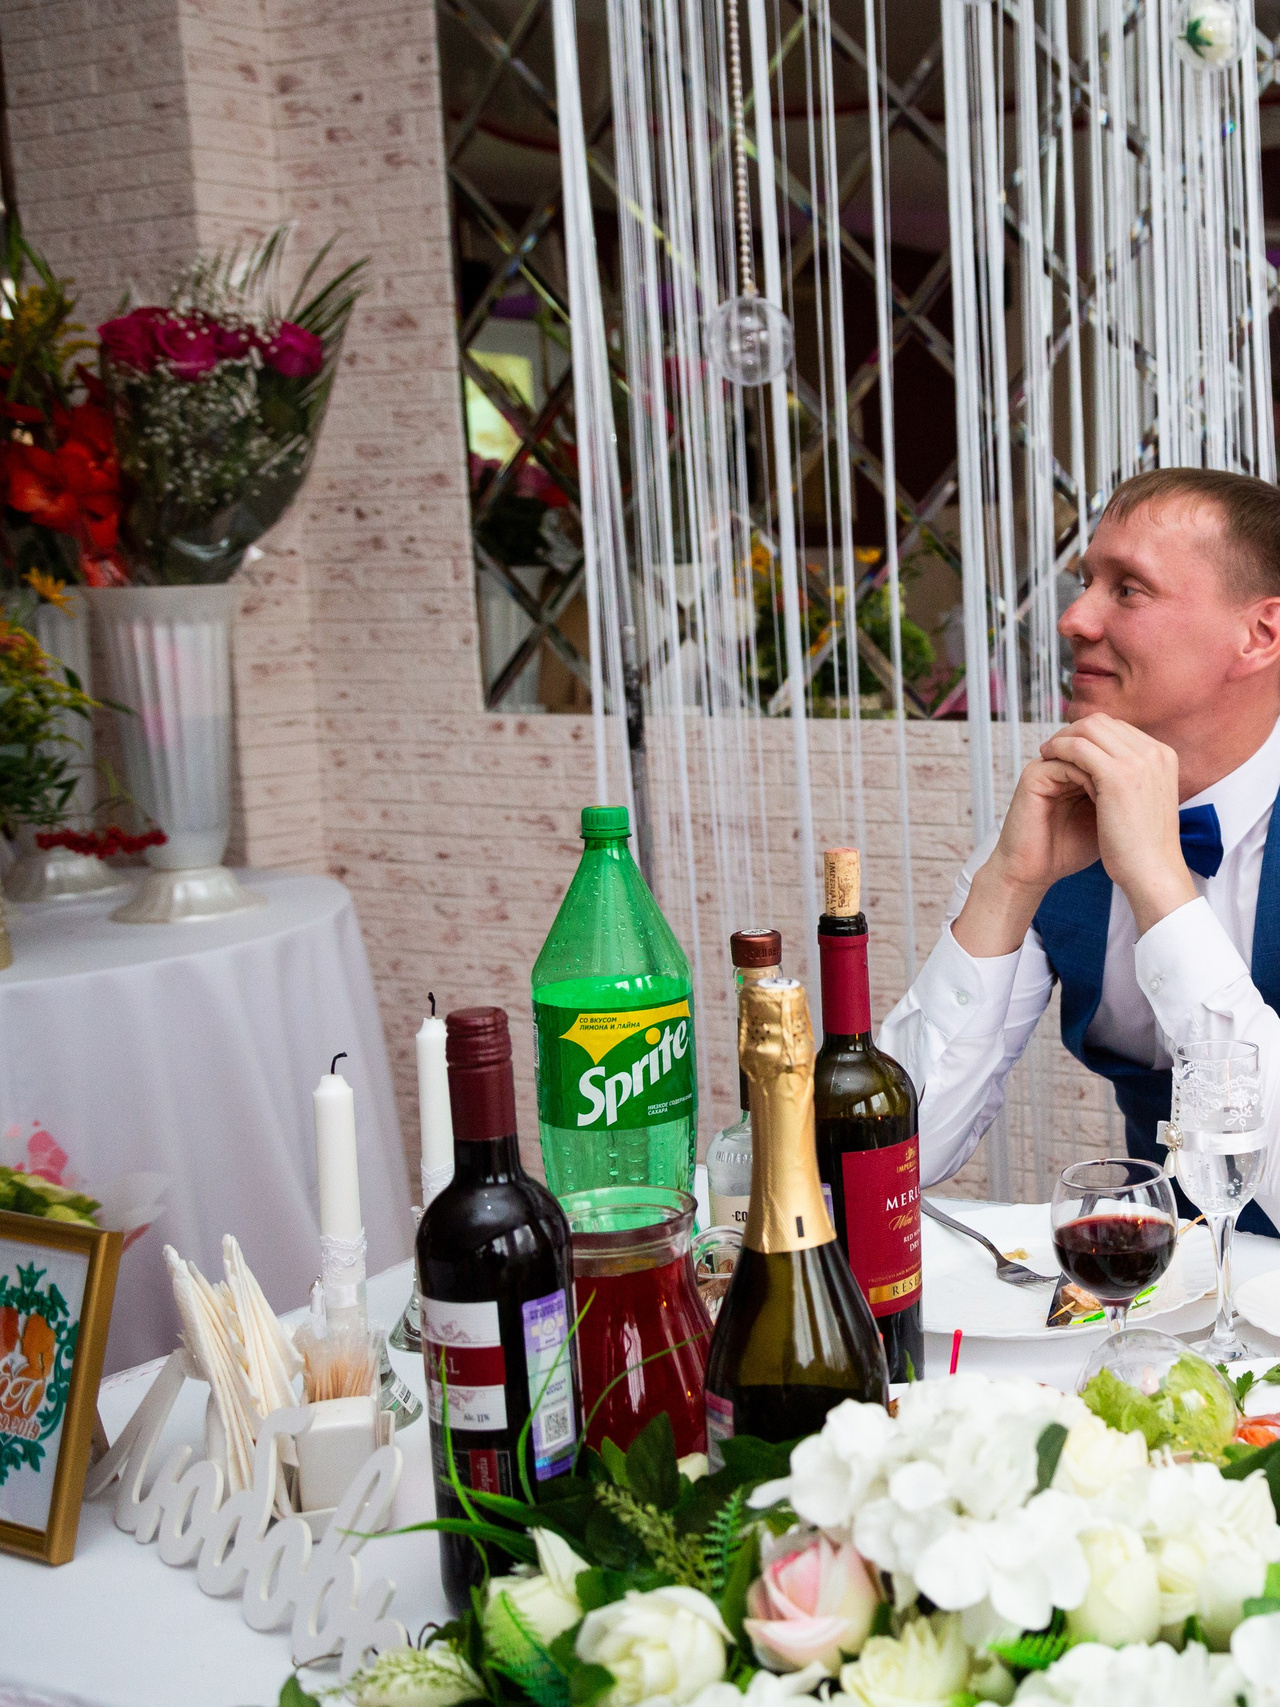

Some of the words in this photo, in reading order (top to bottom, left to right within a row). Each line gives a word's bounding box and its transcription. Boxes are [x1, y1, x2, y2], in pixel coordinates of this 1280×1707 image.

[590, 1016, 617, 1024] ВКУСОМ
[617, 1021, 641, 1030] ЛАЙМА
[577, 1019, 689, 1127] Sprite
